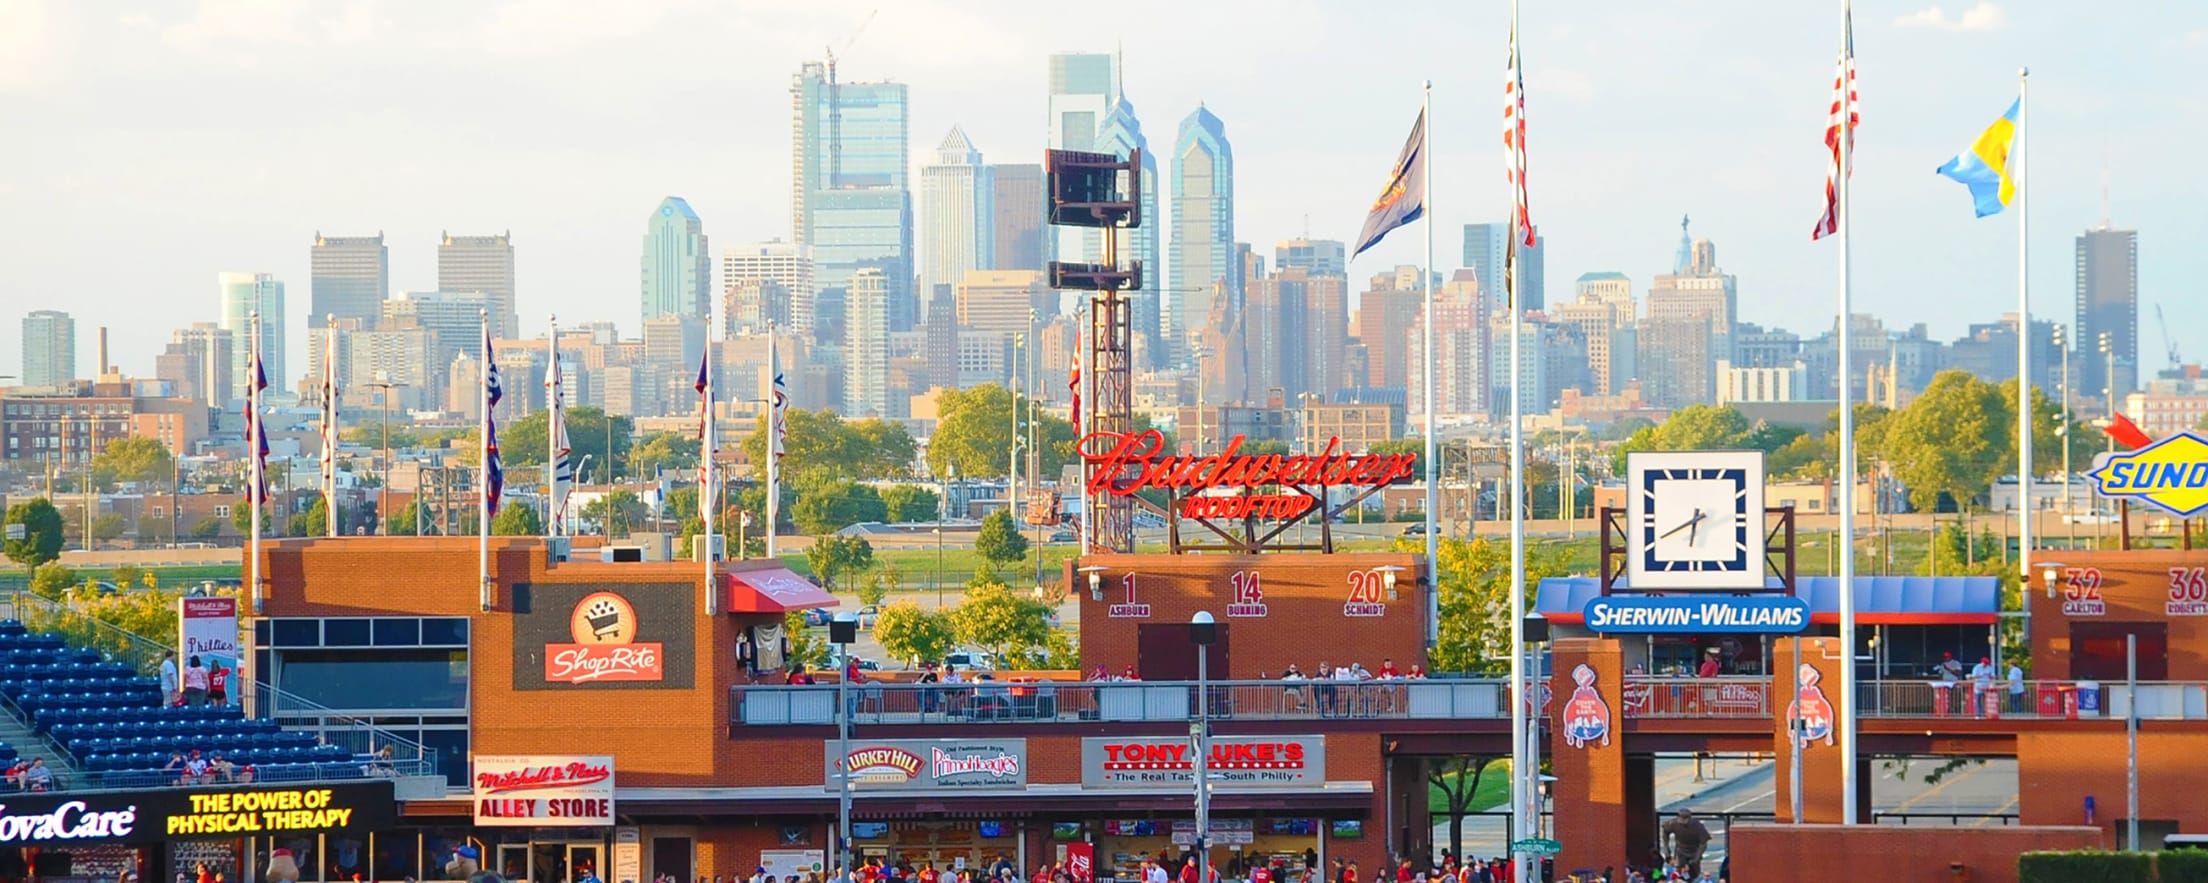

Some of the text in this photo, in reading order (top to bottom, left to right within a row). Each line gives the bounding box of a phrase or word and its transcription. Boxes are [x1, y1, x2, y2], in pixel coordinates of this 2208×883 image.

[1076, 429, 1417, 496] Budweiser
[1182, 494, 1316, 519] ROOFTOP
[1122, 571, 1136, 603] 1
[1231, 571, 1262, 604] 14
[1347, 570, 1382, 603] 20
[2065, 567, 2101, 601] 32
[2169, 567, 2205, 601] 36
[1109, 604, 1150, 616] ASHBURN
[1227, 604, 1267, 616] BUNNING
[1344, 604, 1385, 615] SCHMIDT
[1591, 603, 1803, 625] SHERWIN-WILLIAMS
[2064, 602, 2103, 614] CARLTON
[187, 637, 233, 653] Phillies
[552, 647, 655, 679] ShopRite
[891, 750, 918, 773] HILL
[1104, 743, 1304, 761] TONY UKE'S
[477, 762, 609, 788] Mitchell & Ness
[1115, 773, 1136, 781] The
[1141, 773, 1165, 781] Real
[1223, 772, 1255, 780] South
[1261, 772, 1293, 782] Philly
[189, 790, 332, 813] THE POWER OF
[480, 799, 609, 817] ALLEY STORE
[0, 801, 135, 841] ovaCare
[167, 808, 352, 835] PHYSICAL THERAPY
